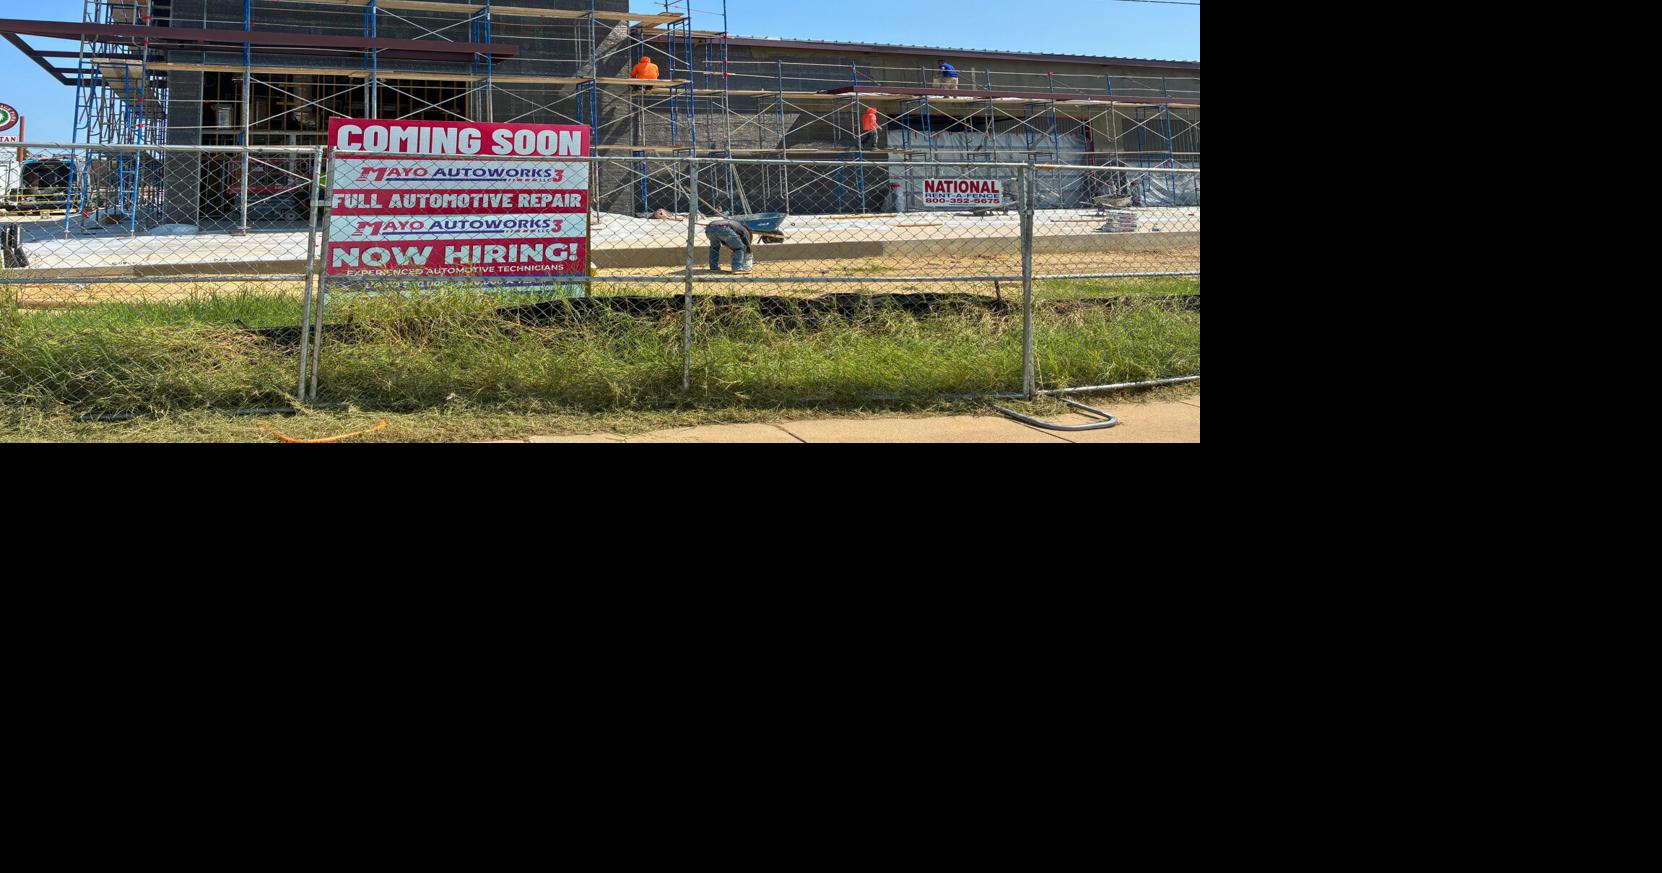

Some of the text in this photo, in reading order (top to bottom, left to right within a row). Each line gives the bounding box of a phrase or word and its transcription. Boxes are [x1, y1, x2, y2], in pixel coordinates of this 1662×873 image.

[337, 125, 582, 156] COMING SOON
[355, 166, 565, 183] MAYO AUTOWORKS 3
[924, 180, 1000, 193] NATIONAL
[331, 193, 582, 209] FULL AUTOMOTIVE REPAIR
[351, 219, 564, 236] MAYO AUTOWORKS 3
[332, 242, 579, 268] NOW HIRING!
[346, 264, 565, 277] EXPERIENCED AUTOMOTIVE TECHNICIANS
